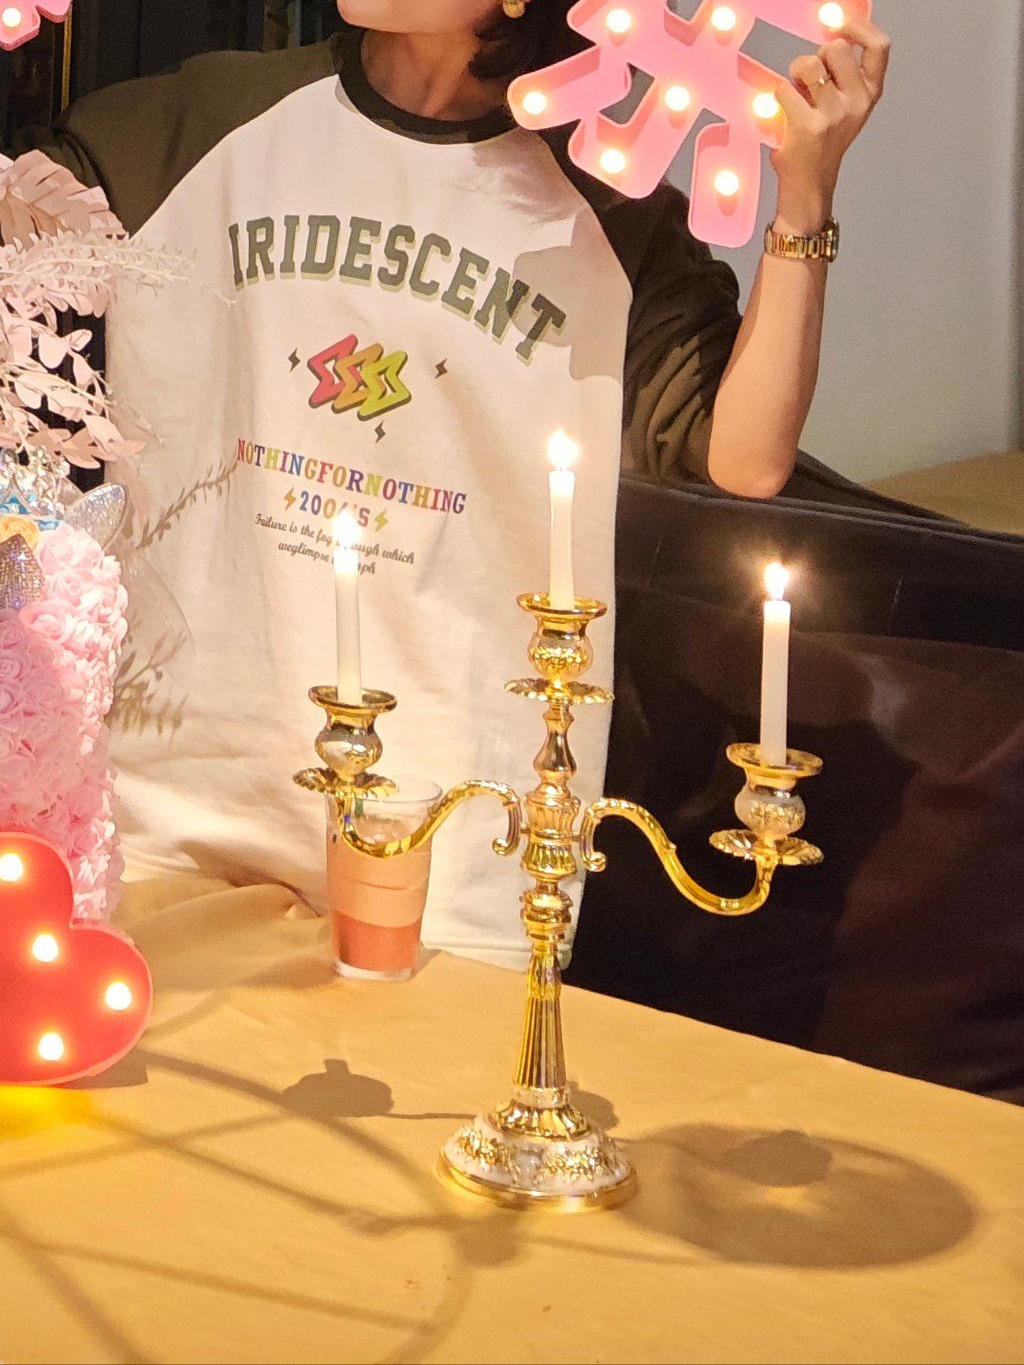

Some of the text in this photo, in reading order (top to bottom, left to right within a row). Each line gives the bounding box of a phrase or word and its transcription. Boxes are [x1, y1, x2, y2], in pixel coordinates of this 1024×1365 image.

[228, 214, 567, 366] IRIDESCENT
[237, 438, 467, 514] NOTHINGFORNOTHING
[255, 513, 287, 531] Failure
[289, 521, 298, 534] is
[301, 524, 314, 539] the
[316, 528, 332, 546] fog
[382, 547, 415, 565] which
[299, 490, 371, 527] 200'S
